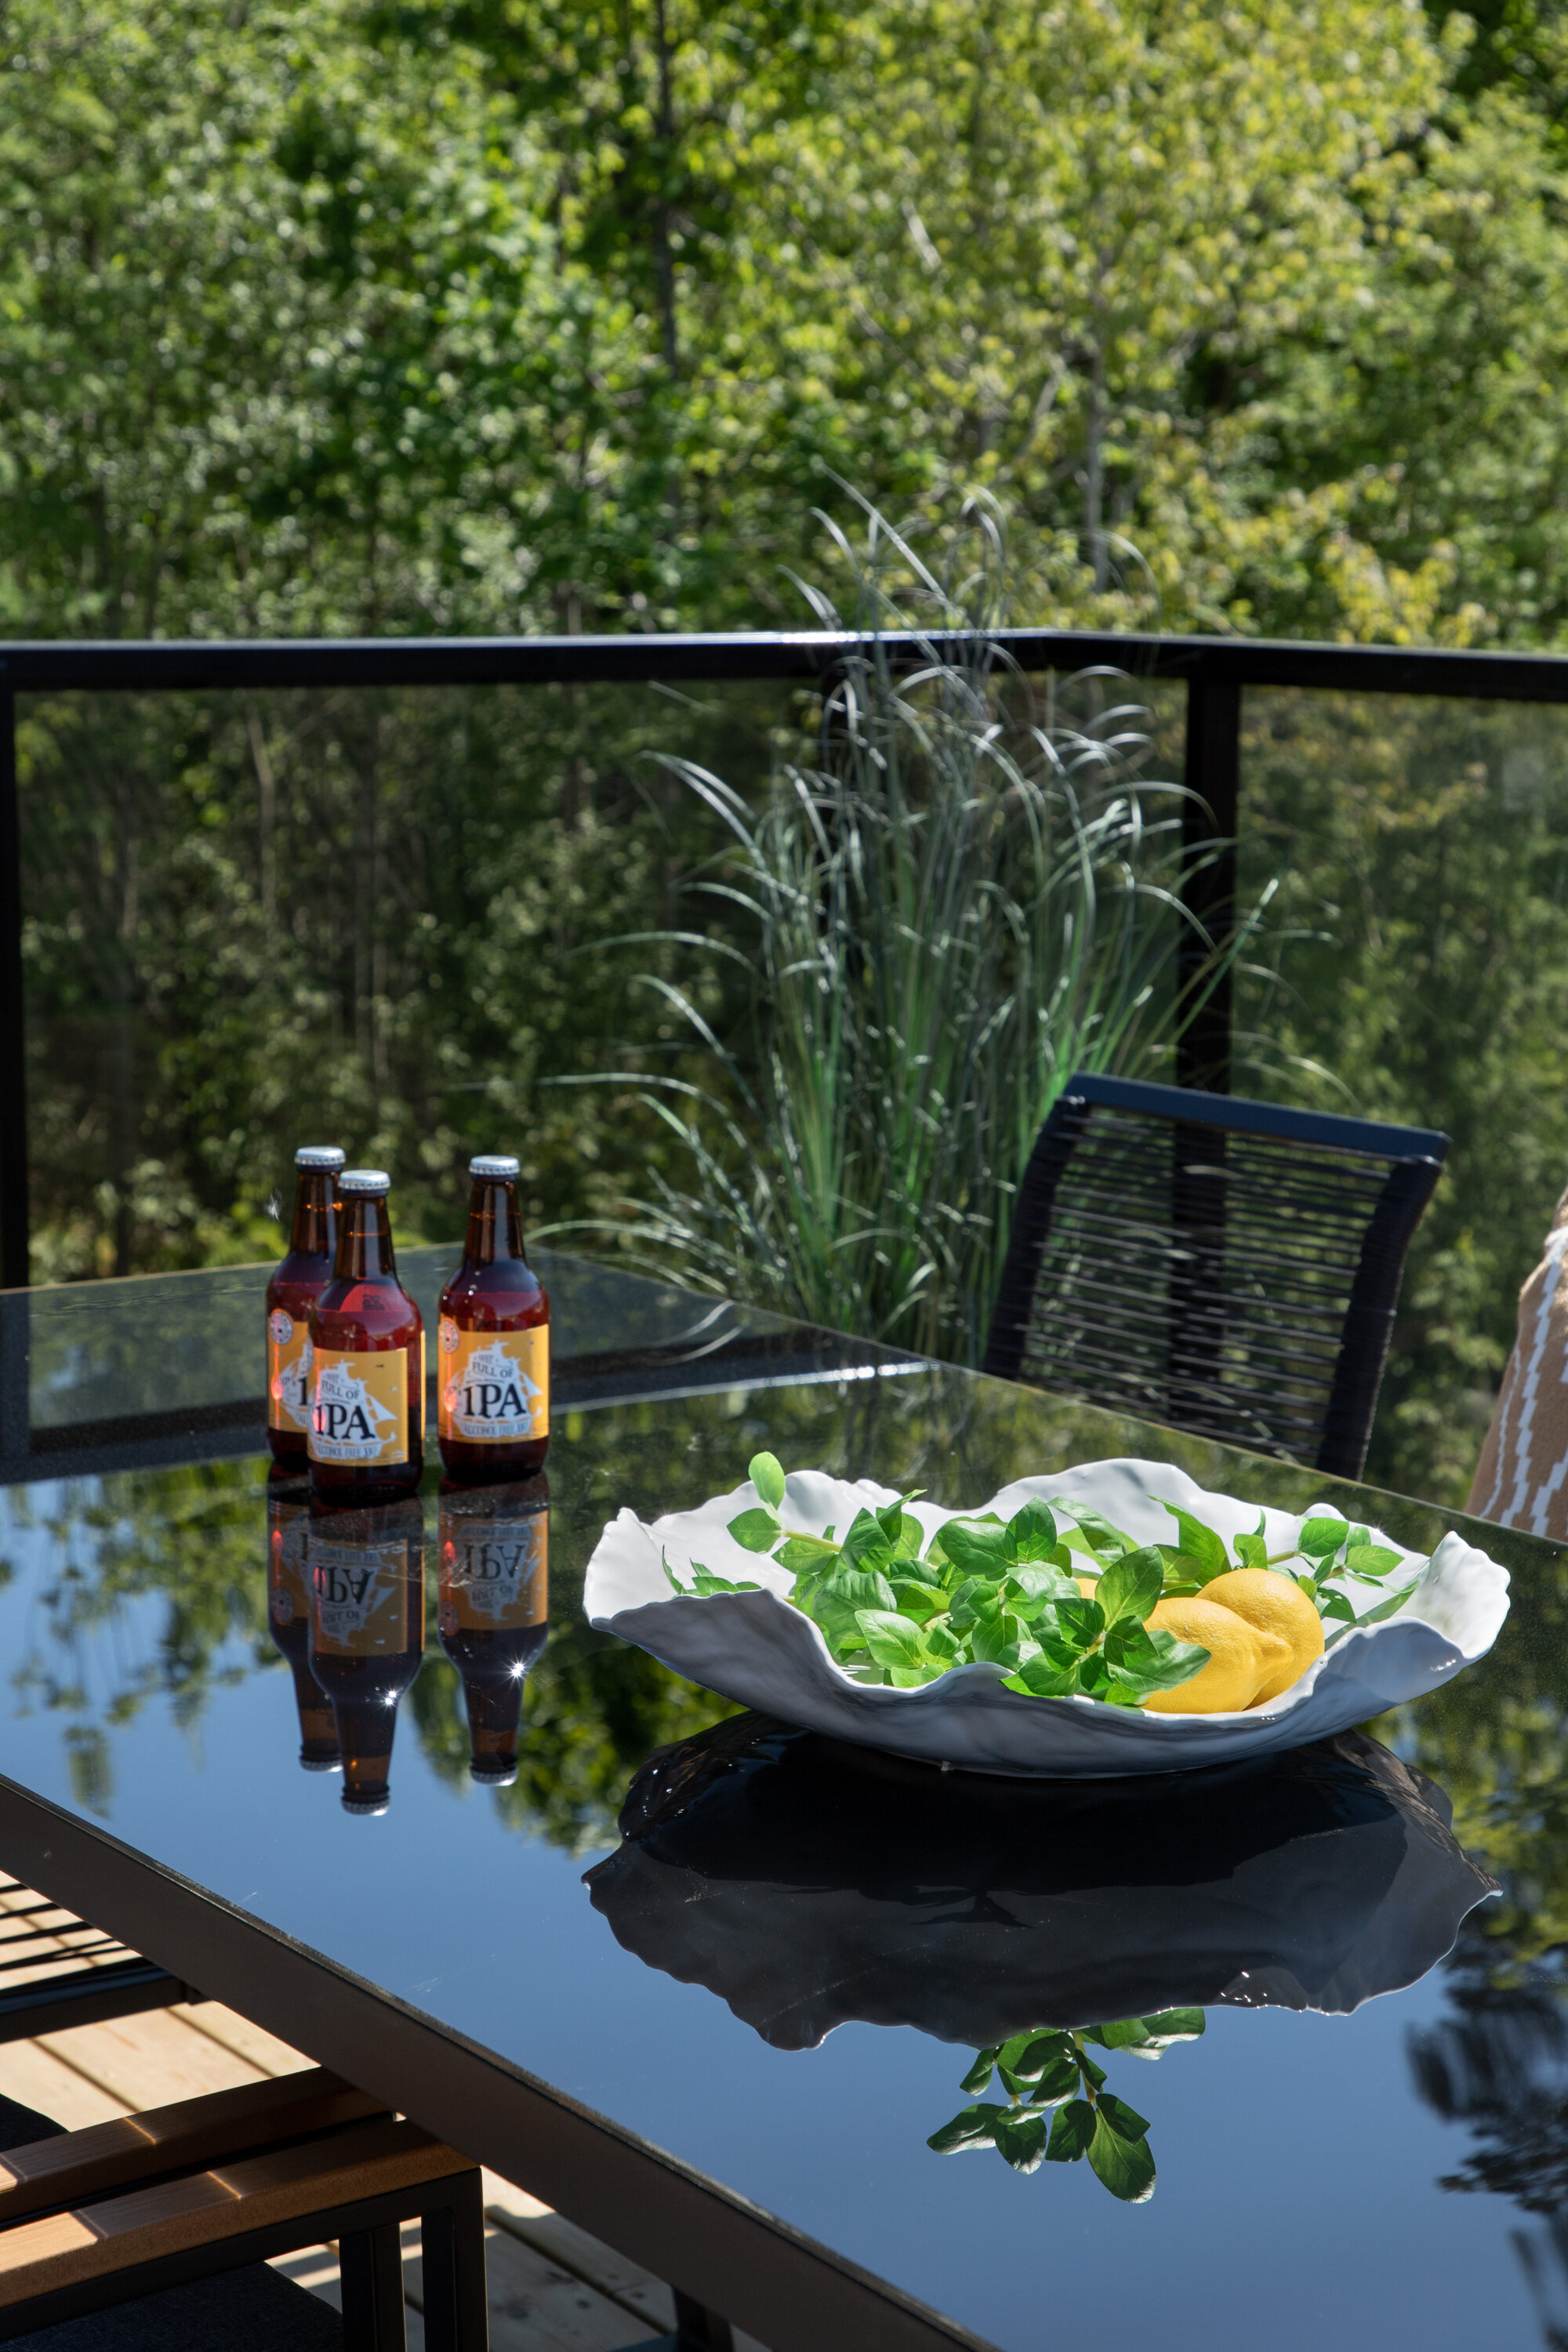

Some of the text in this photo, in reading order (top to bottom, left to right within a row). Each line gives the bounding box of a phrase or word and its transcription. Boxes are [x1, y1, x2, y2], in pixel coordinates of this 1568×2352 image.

[472, 1361, 514, 1378] FULL OF
[321, 1380, 343, 1397] FULL
[346, 1389, 360, 1400] OF
[463, 1382, 527, 1419] IPA
[314, 1403, 376, 1440] IPA
